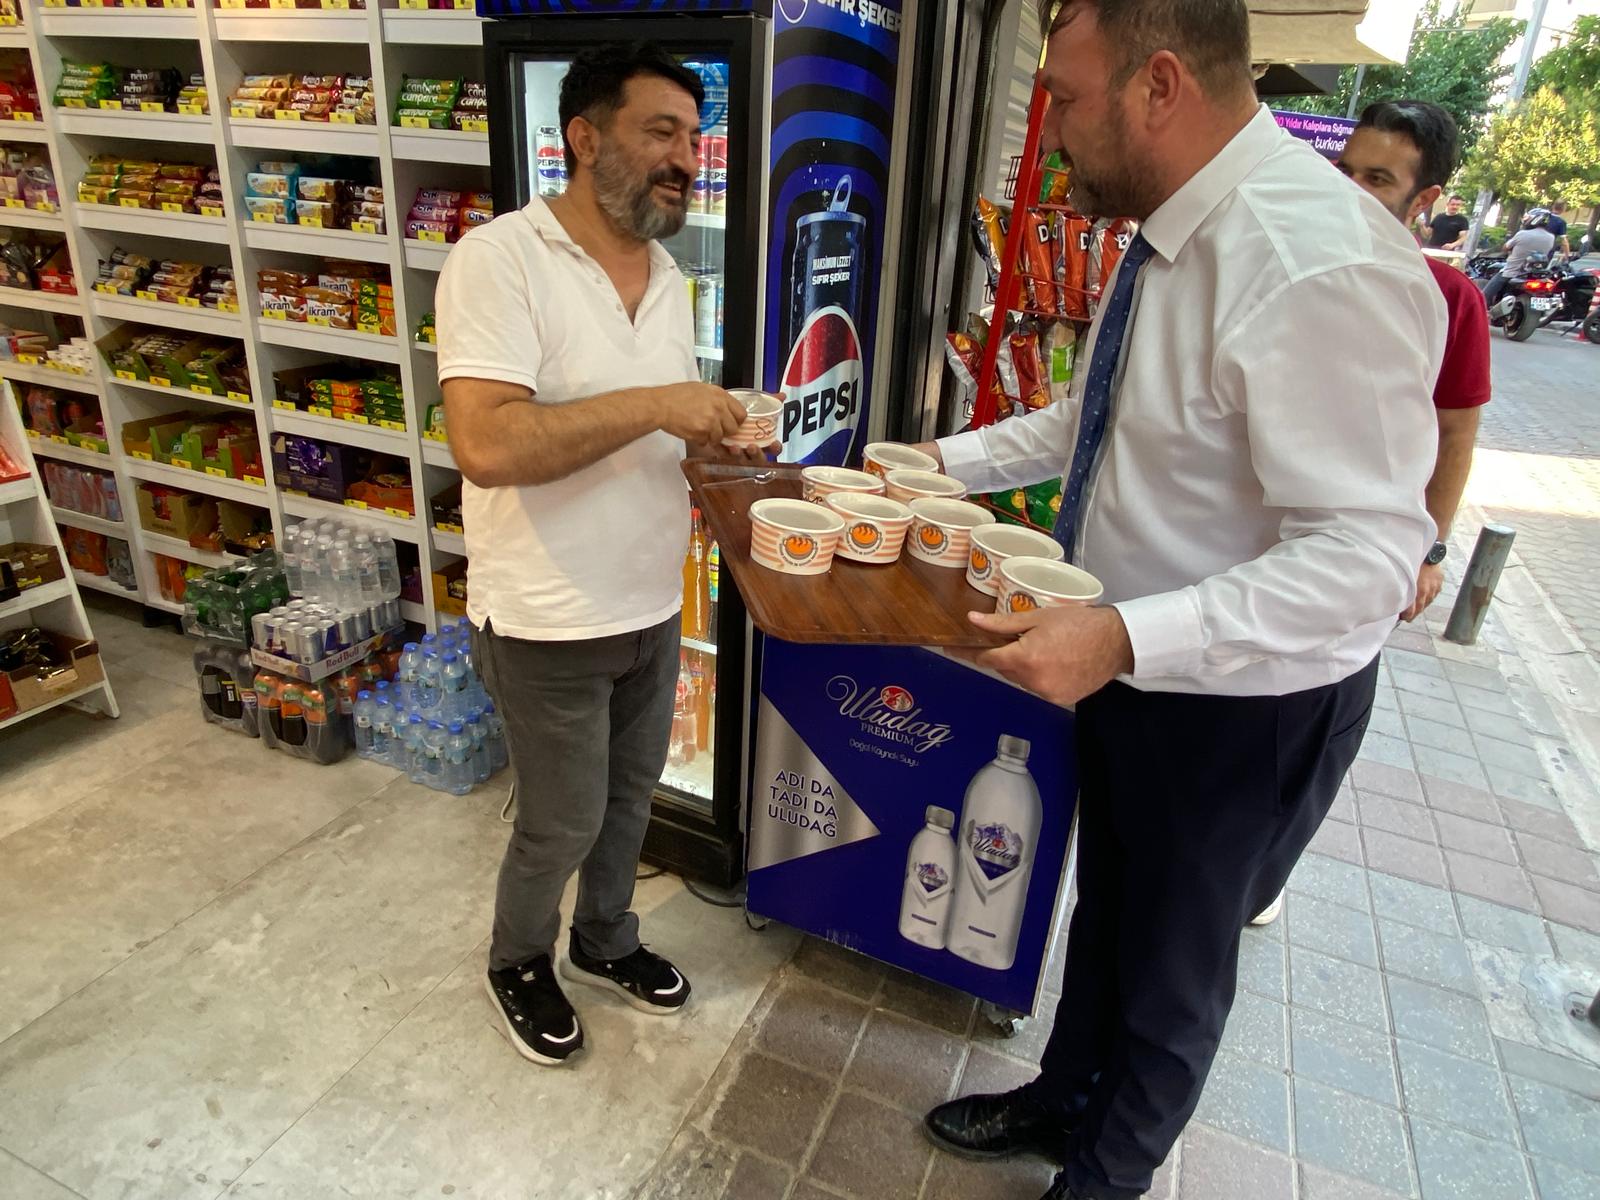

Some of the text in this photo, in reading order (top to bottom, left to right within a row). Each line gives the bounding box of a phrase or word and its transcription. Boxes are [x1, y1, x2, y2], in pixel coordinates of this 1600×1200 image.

[1303, 119, 1331, 133] Kalıplara
[308, 306, 336, 317] ikram
[782, 377, 859, 444] PEPSI
[825, 674, 955, 754] Uludağ
[860, 721, 915, 747] PREMIUM
[775, 769, 836, 800] ADI DA
[769, 785, 838, 820] TADI DA
[767, 803, 837, 838] ULUDAĞ
